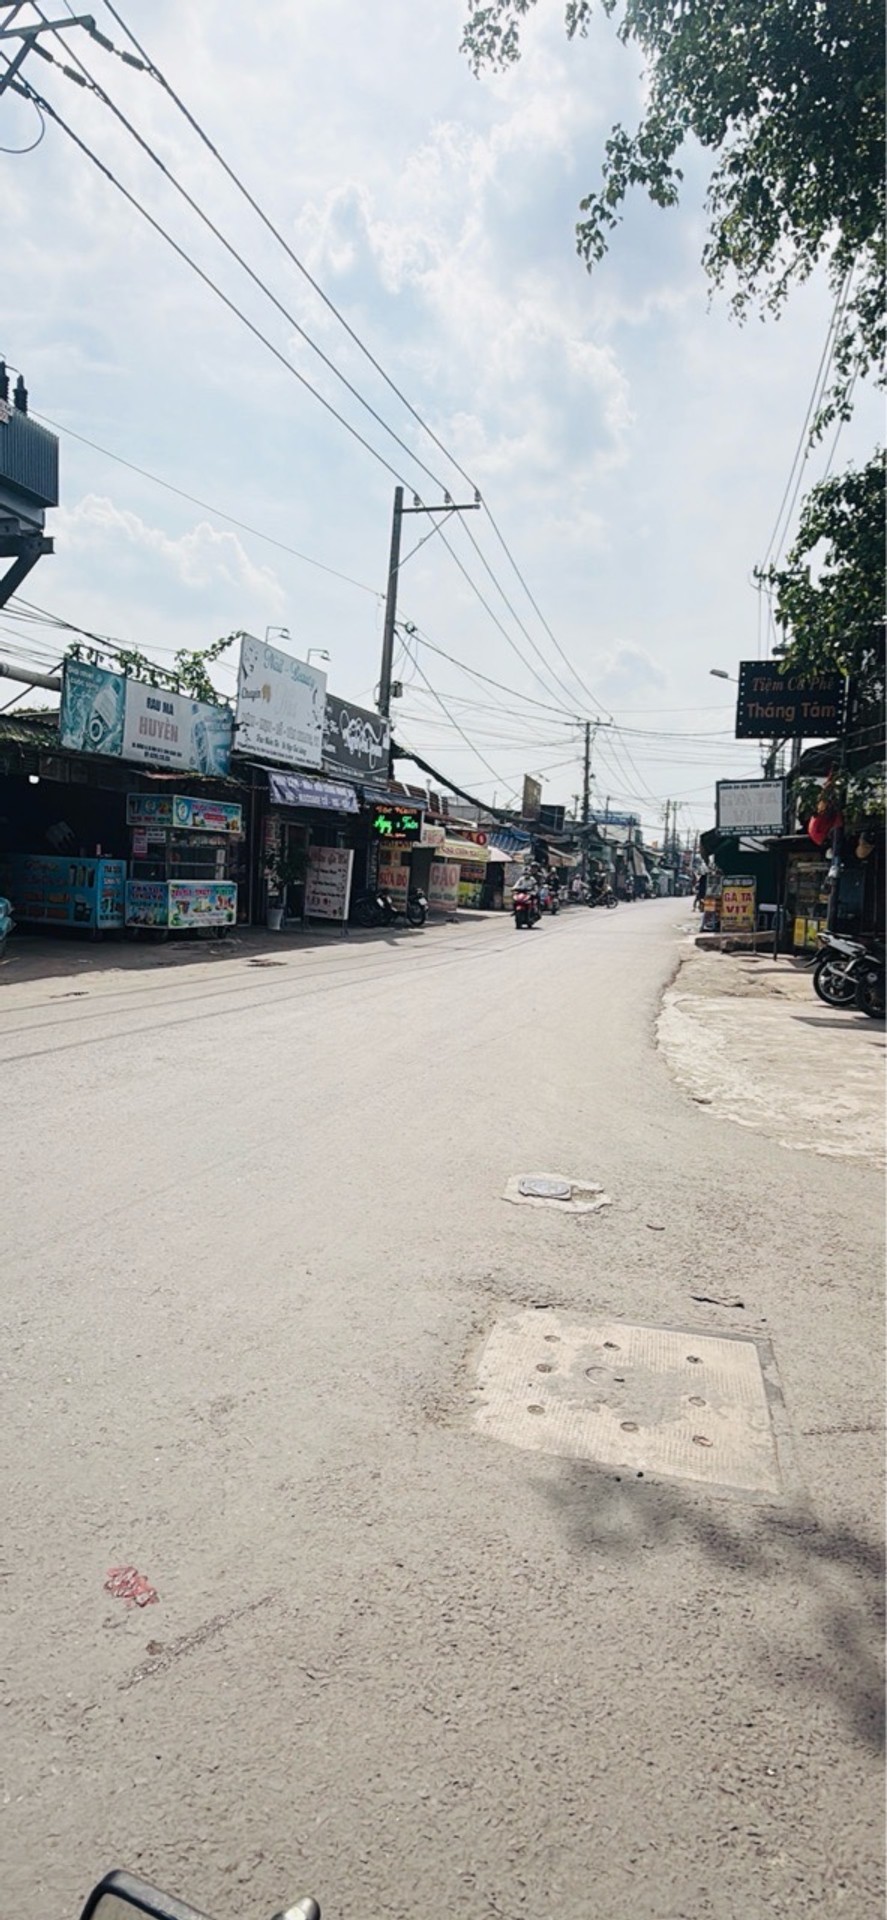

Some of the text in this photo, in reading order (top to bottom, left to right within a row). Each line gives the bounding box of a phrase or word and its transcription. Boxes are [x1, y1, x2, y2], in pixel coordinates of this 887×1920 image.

[752, 676, 784, 693] Tiệm
[747, 701, 836, 722] Tháng Tám
